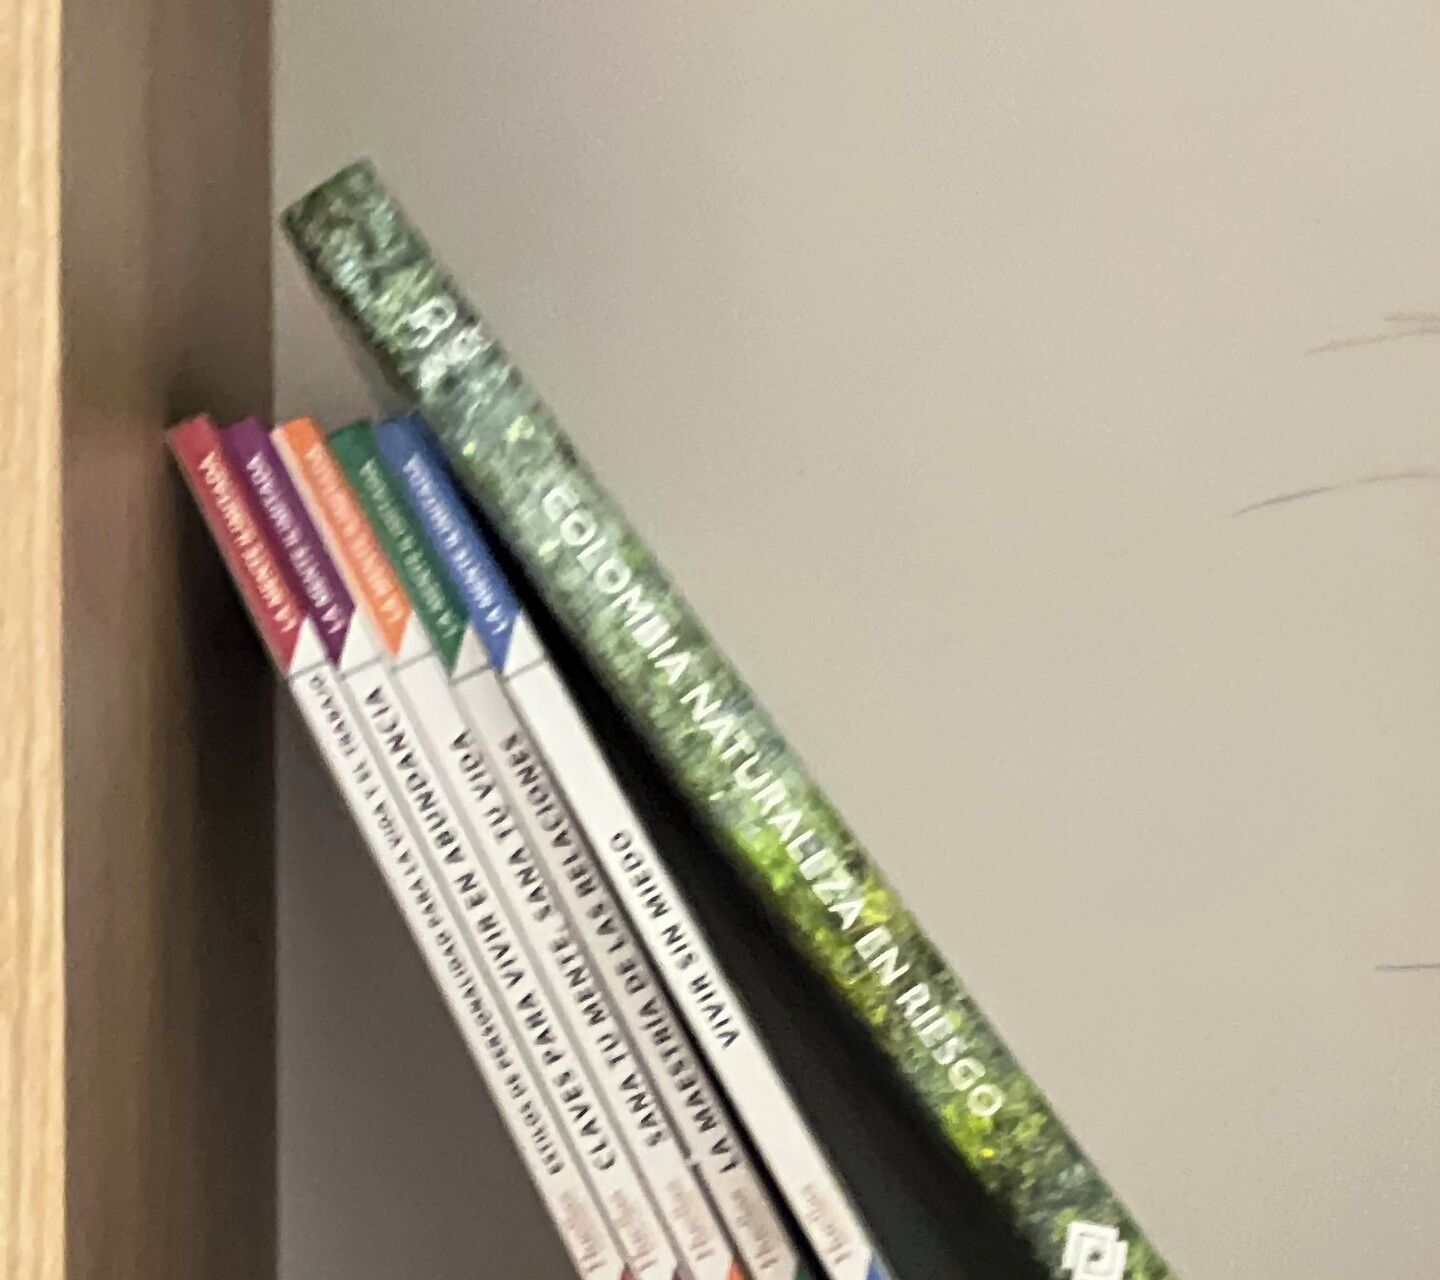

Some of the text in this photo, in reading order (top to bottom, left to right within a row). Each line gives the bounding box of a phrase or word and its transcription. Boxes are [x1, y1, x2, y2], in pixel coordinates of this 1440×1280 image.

[310, 675, 357, 757] TRABAJO
[366, 687, 465, 864] ABUNDANCIA
[452, 730, 496, 800] VIDA
[368, 801, 403, 848] VIDA
[486, 807, 515, 847] TU
[505, 733, 597, 898] RELACIONES
[541, 482, 1005, 1125] COLOMBIA NATURALEZA EN RIESGO
[393, 850, 417, 876] LA
[456, 872, 486, 908] EN
[509, 847, 552, 921] SANA
[410, 877, 442, 928] PARA
[585, 903, 625, 952] LAS
[478, 914, 524, 988] VIVIR
[612, 832, 740, 1048] VIVIR SIN MIEDO
[615, 955, 646, 994] DE
[437, 931, 512, 1070] PERSONALIDAD
[517, 992, 564, 1065] PARA
[506, 1073, 527, 1099] DE
[597, 1033, 627, 1067] TU
[520, 1100, 564, 1175] ESTILOS
[558, 1071, 615, 1170] CLAVES
[620, 1073, 663, 1147] SANA
[706, 1137, 738, 1173] LA
